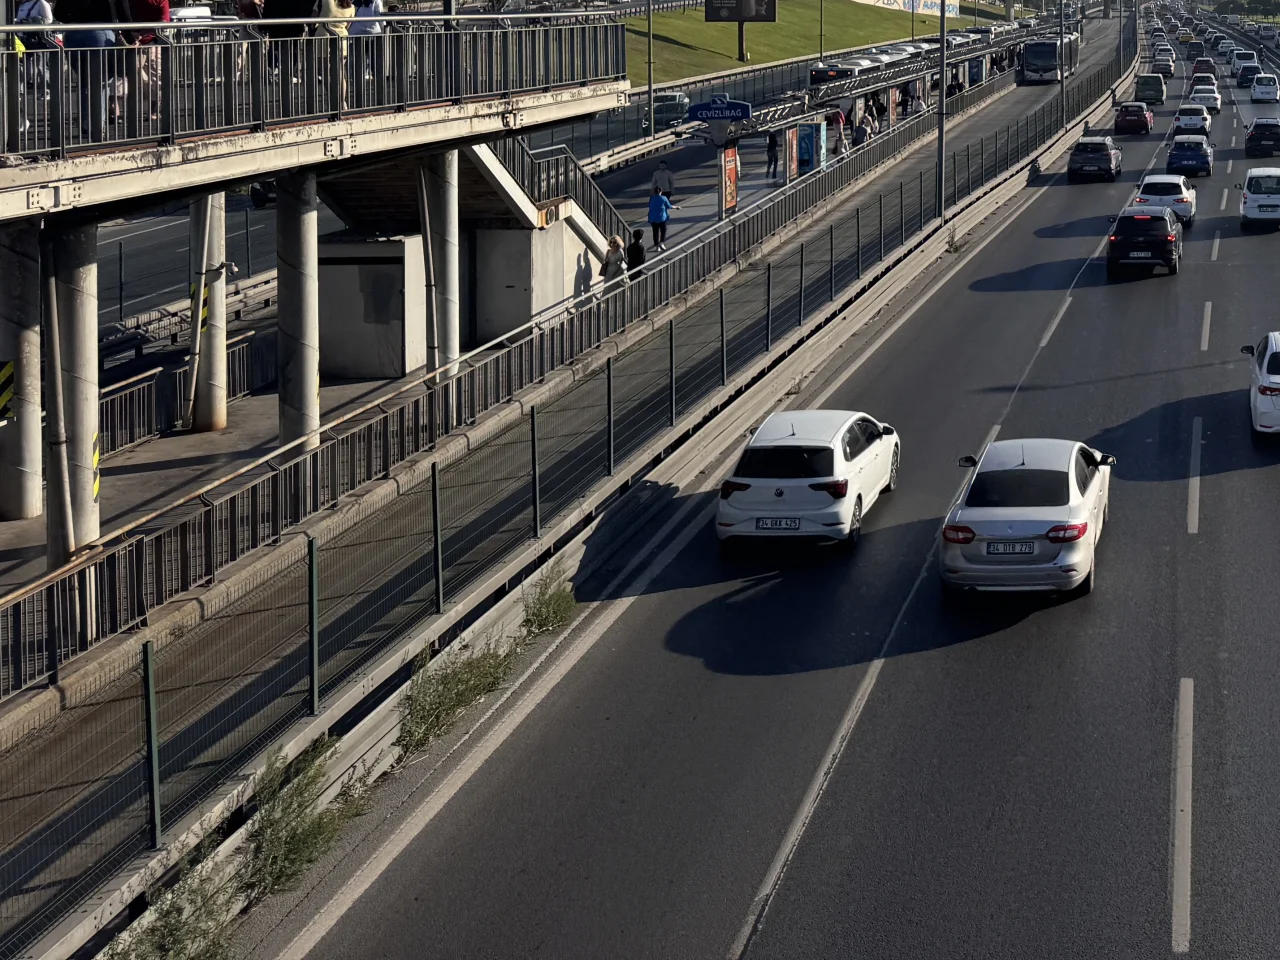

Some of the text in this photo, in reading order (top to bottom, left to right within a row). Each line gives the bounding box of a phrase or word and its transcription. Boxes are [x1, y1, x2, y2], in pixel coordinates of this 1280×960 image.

[697, 107, 742, 118] CEVİZLİBAĞ
[760, 518, 769, 527] 34
[991, 544, 1000, 552] 34
[1019, 543, 1032, 552] 279
